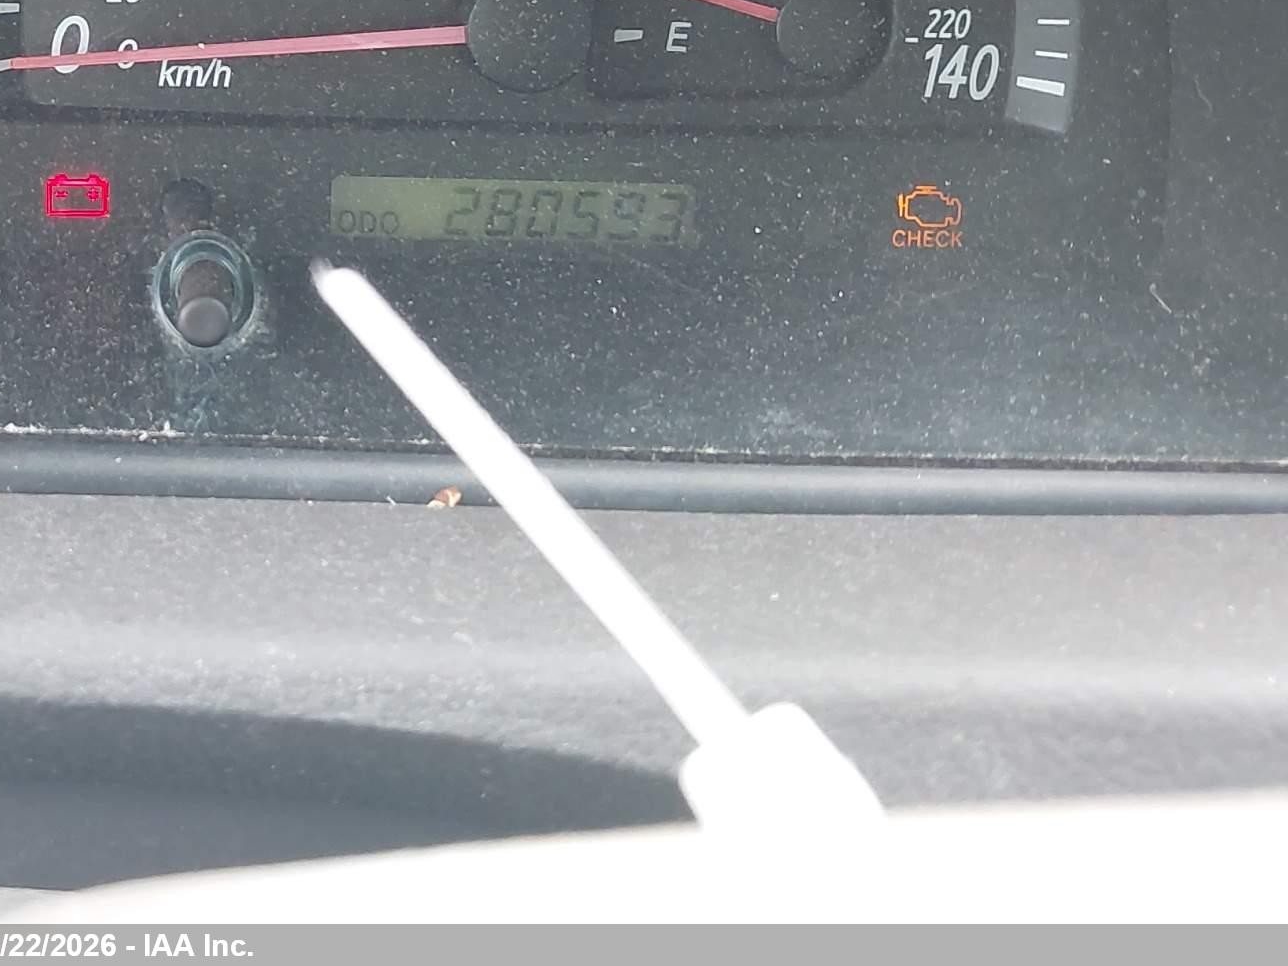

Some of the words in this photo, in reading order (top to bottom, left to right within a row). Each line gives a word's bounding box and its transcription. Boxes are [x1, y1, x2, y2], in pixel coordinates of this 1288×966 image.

[665, 22, 692, 52] E
[924, 10, 971, 39] 220
[51, 16, 89, 73] 0
[158, 58, 232, 88] km/h
[922, 44, 999, 100] 140
[338, 210, 399, 234] ODO
[445, 187, 687, 242] 280593
[891, 230, 963, 248] CHECK
